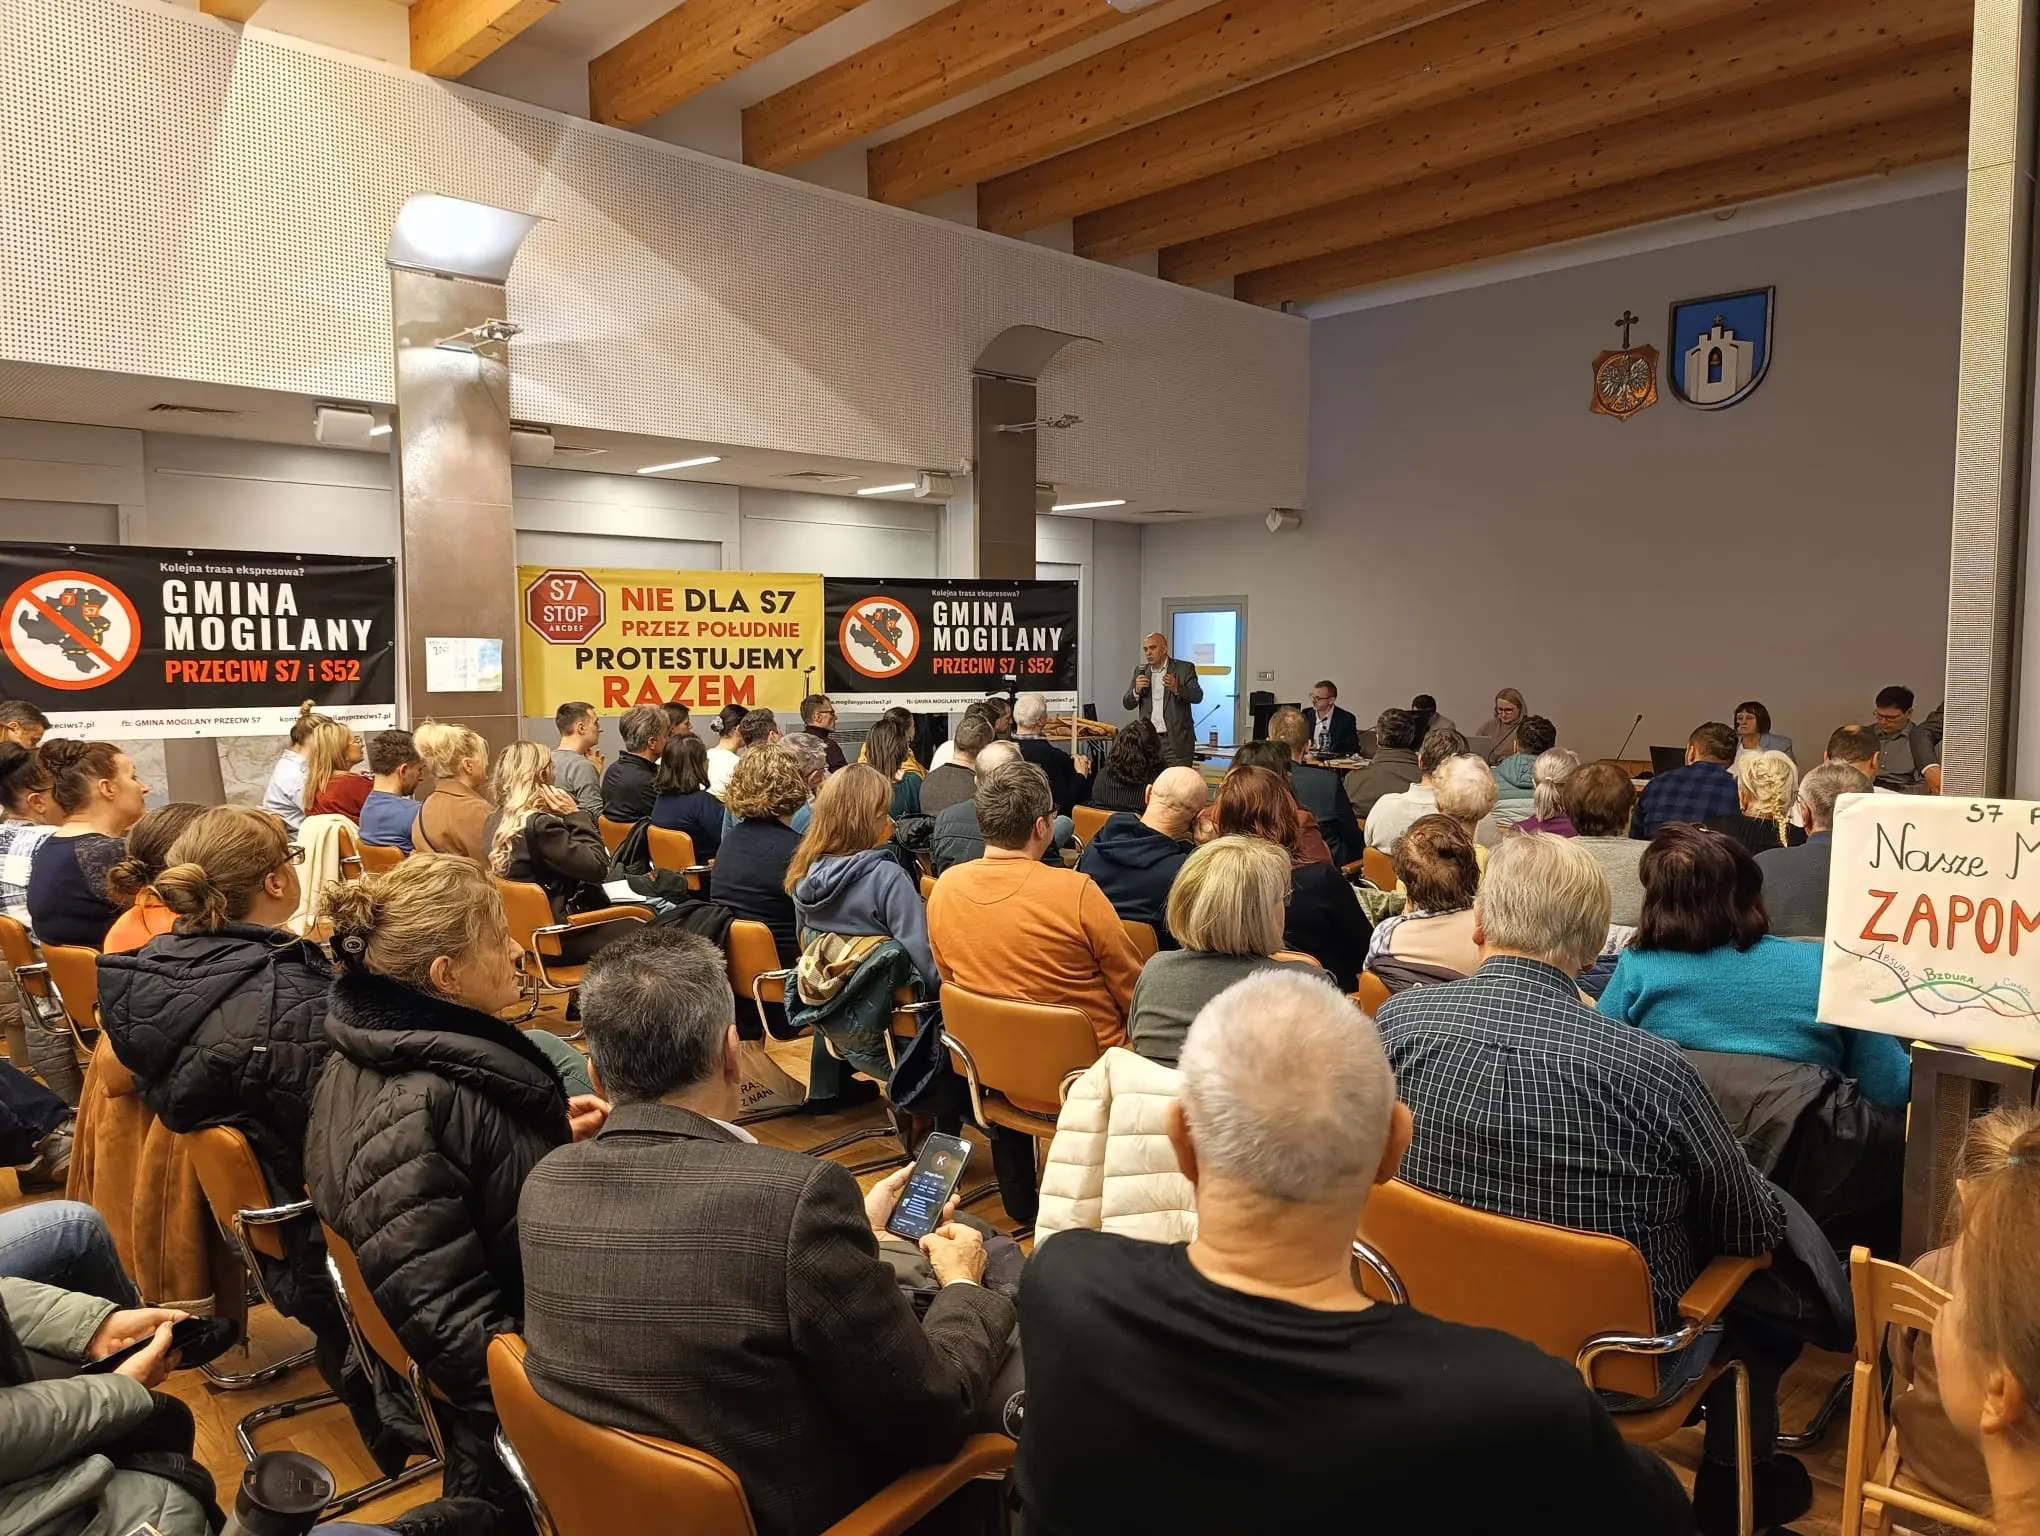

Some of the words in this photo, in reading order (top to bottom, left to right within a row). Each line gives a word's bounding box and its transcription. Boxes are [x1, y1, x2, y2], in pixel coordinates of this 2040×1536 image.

[160, 562, 202, 575] Kolejna
[205, 564, 234, 574] trasa
[236, 565, 305, 576] ekspresowa?
[162, 579, 299, 616] GMINA
[549, 578, 578, 601] S7
[621, 587, 673, 612] NIE
[684, 588, 750, 613] DLA
[760, 589, 796, 614] S7
[931, 589, 957, 598] Kolejna
[958, 589, 976, 597] trasa
[977, 589, 1020, 598] ekspresowa?
[543, 605, 589, 623] STOP
[932, 600, 1015, 626] GMINA
[164, 615, 373, 651] MOGILANY
[549, 624, 584, 632] ABCDEF
[621, 620, 690, 637] PRZEZ
[697, 621, 800, 638] POŁUDNIE
[933, 626, 1063, 652] MOGILANY
[575, 646, 804, 670] PROTESTUJEMY
[933, 657, 995, 675] PRZECIW
[999, 657, 1016, 675] S7
[1020, 660, 1024, 674] i
[1027, 657, 1054, 674] S52
[165, 659, 269, 683] PRZECIW
[274, 659, 300, 682] S7
[307, 663, 315, 682] i
[320, 659, 361, 682] S52
[603, 675, 756, 708] RAZEM
[135, 719, 164, 727] GMINA
[166, 718, 212, 726] MOGILANY
[251, 716, 261, 724] S7
[1966, 804, 2003, 823] S7
[1869, 822, 1989, 878] Nasze
[1859, 889, 2040, 957] ZAPOM
[936, 1155, 948, 1166] K
